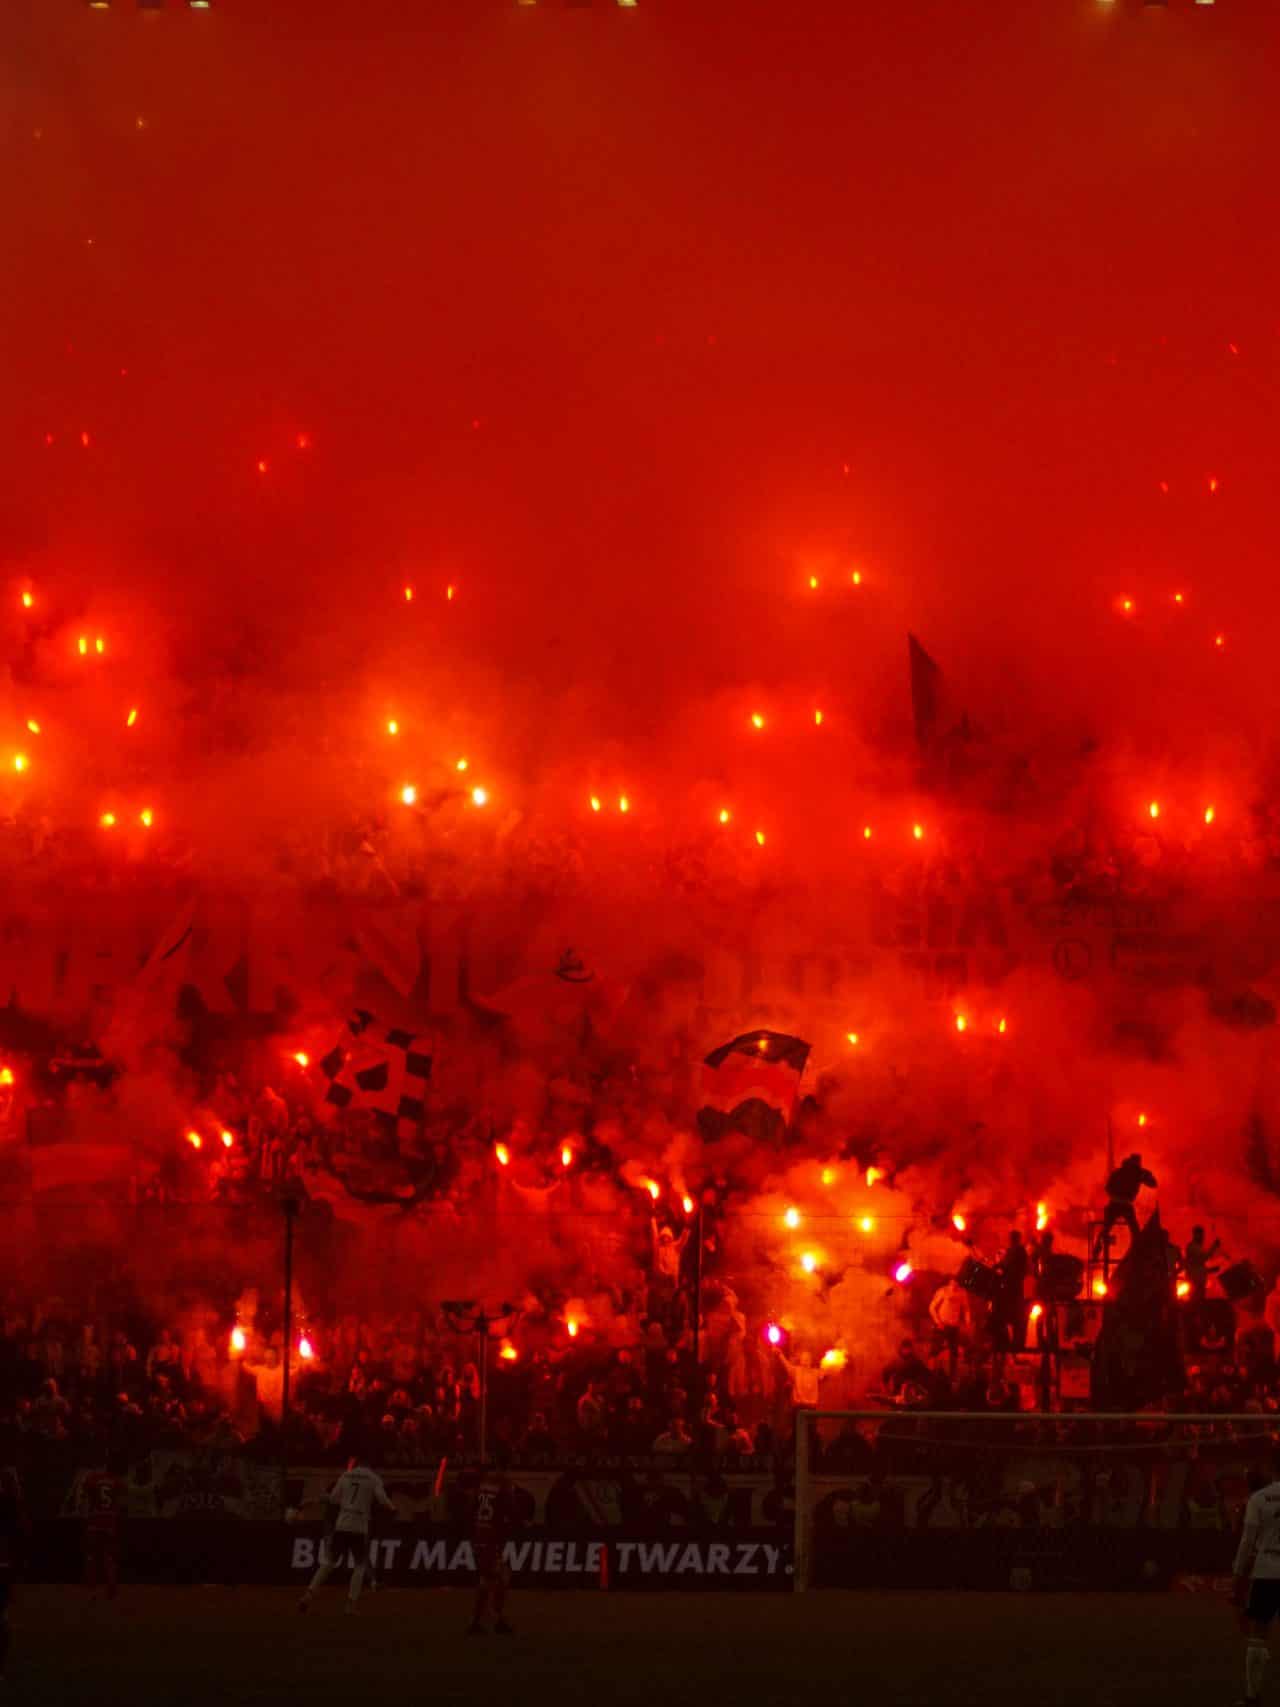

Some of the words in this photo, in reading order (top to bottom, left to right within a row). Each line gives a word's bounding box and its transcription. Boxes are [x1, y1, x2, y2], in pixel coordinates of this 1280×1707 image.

[351, 1482, 361, 1502] 7
[410, 1541, 477, 1570] MA
[502, 1541, 606, 1572] WIELE
